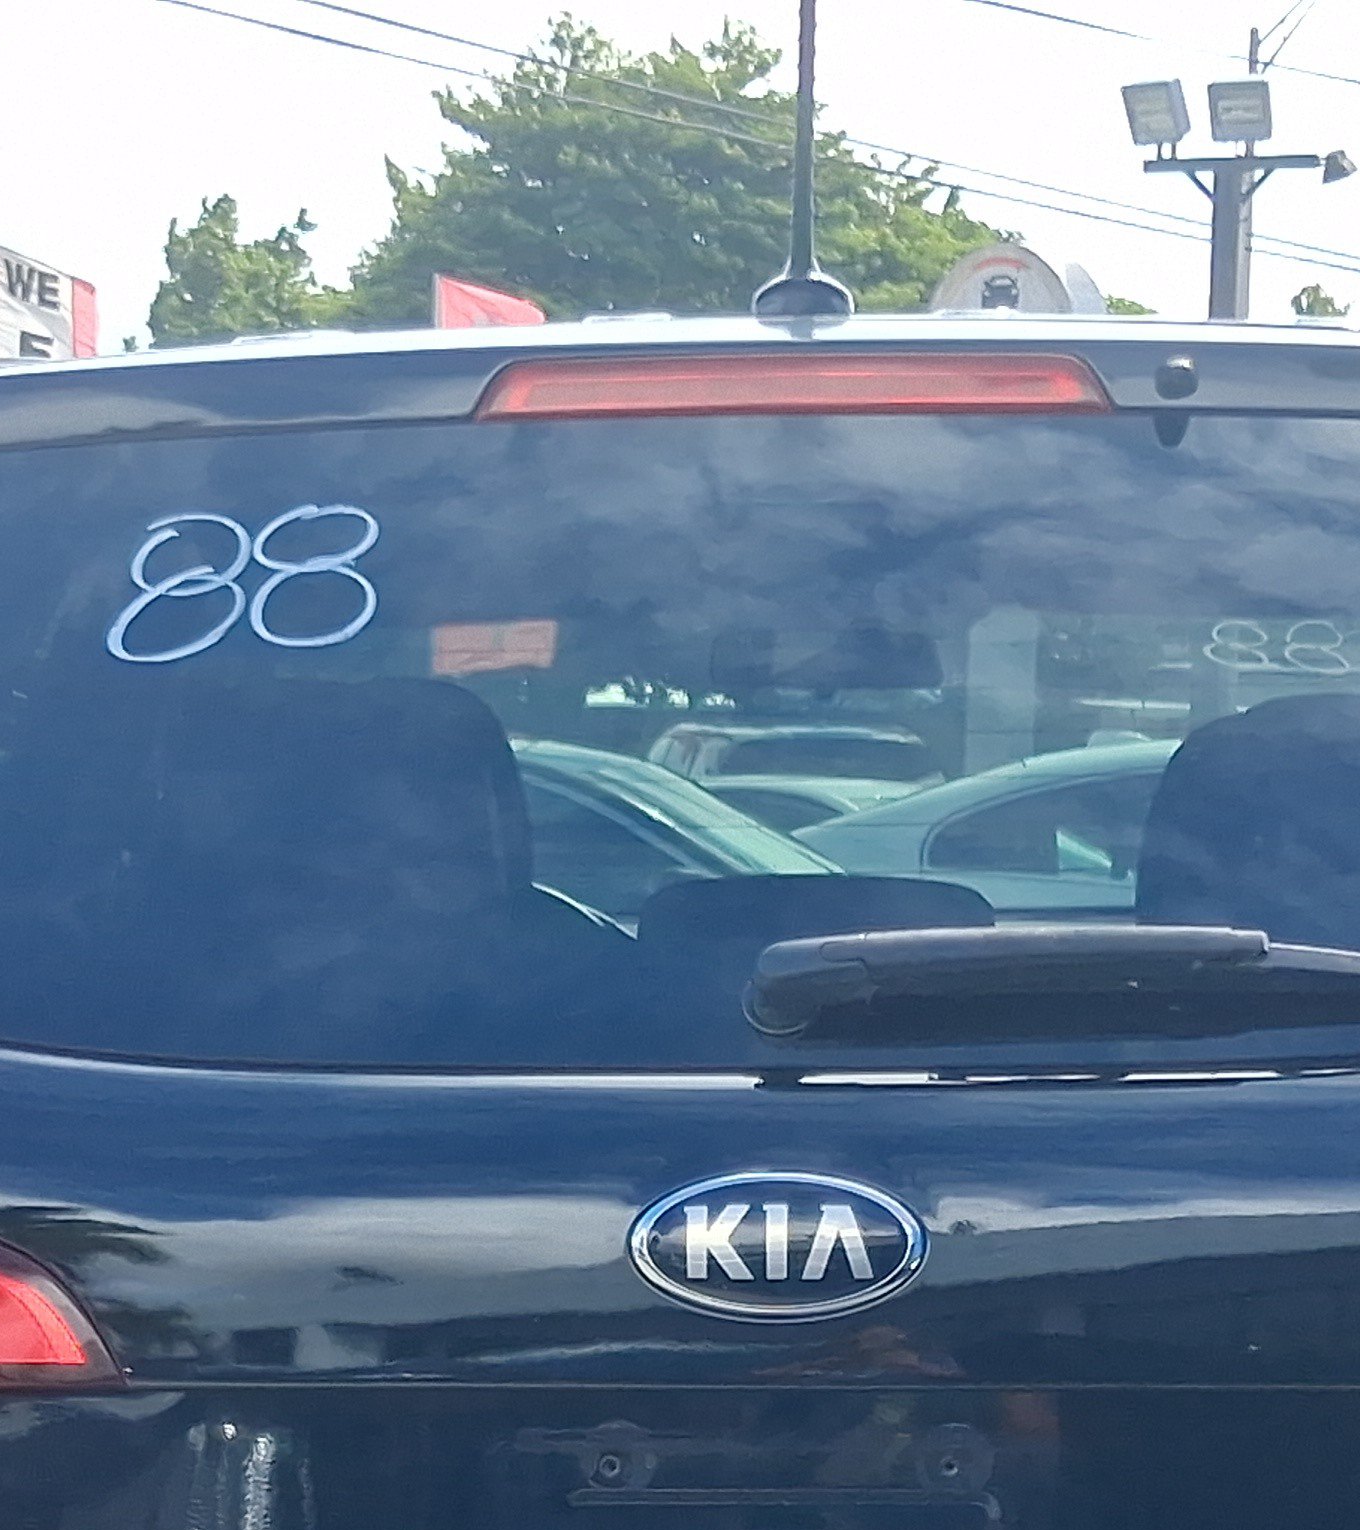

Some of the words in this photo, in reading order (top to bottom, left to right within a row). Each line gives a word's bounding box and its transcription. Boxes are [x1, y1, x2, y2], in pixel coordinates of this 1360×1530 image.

[3, 258, 60, 312] WE
[106, 503, 380, 663] 88
[683, 1203, 875, 1281] KIA
